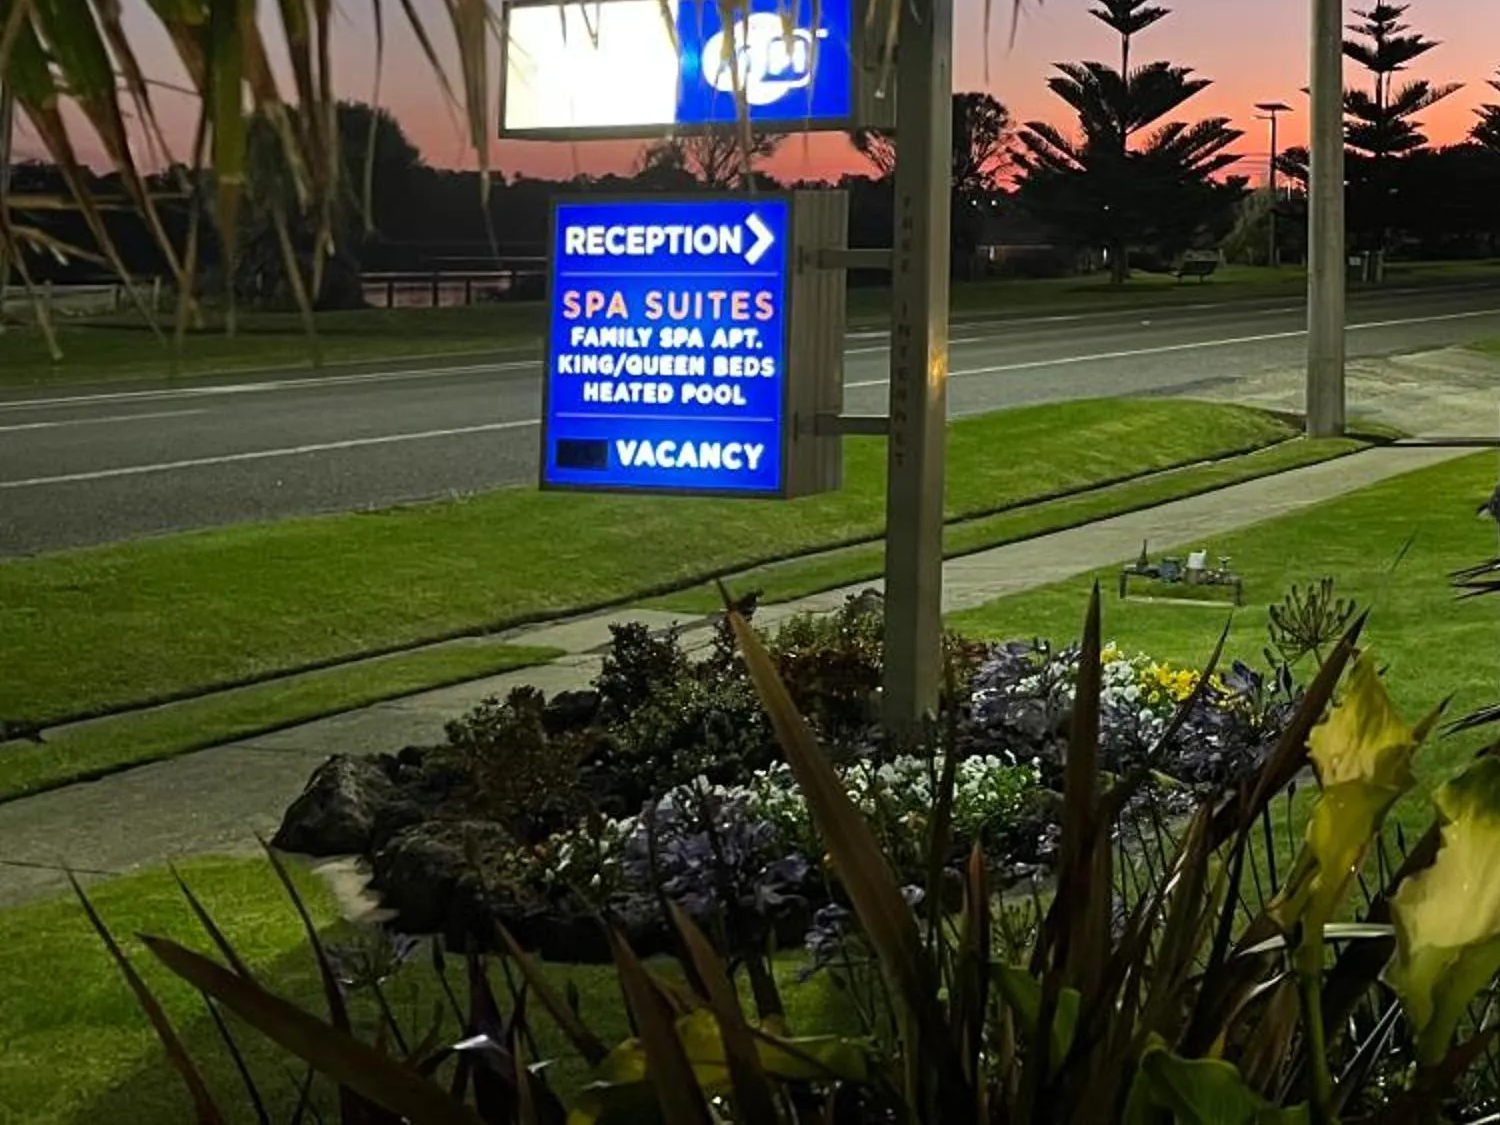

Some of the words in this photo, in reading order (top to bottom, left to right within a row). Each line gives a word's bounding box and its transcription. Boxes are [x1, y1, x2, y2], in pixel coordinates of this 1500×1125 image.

[565, 225, 742, 255] RECEPTION
[563, 290, 629, 319] SPA
[645, 290, 774, 321] SUITES
[571, 327, 652, 349] FAMILY
[659, 327, 704, 349] SPA
[711, 328, 763, 349] APT.
[558, 353, 705, 378] KING/QUEEN
[713, 356, 775, 378] BEDS
[583, 382, 674, 404] HEATED
[681, 384, 747, 406] POOL
[615, 439, 764, 470] VACANCY
